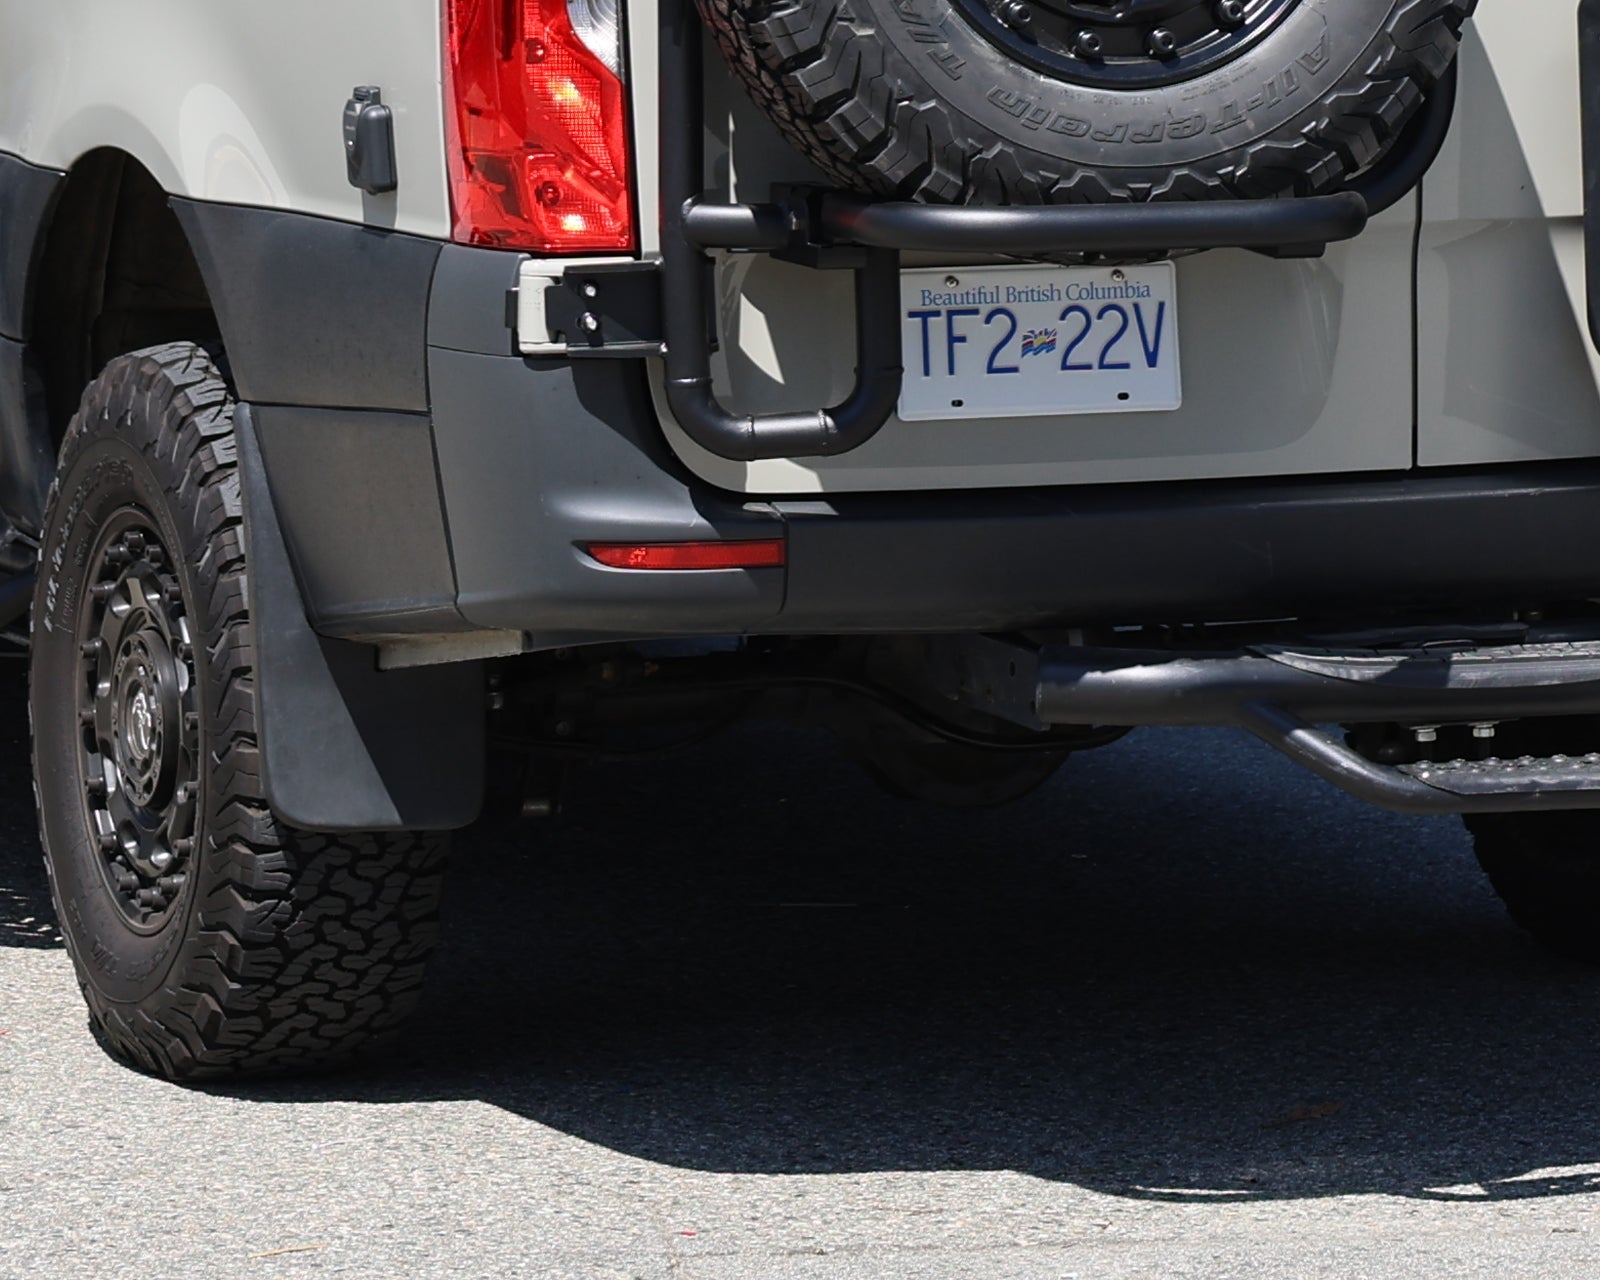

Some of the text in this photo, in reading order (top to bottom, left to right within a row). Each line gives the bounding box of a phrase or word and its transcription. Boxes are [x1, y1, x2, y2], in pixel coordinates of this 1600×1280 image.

[920, 281, 1151, 307] Beautiful British Columbia
[907, 301, 1165, 377] TF2 22V
